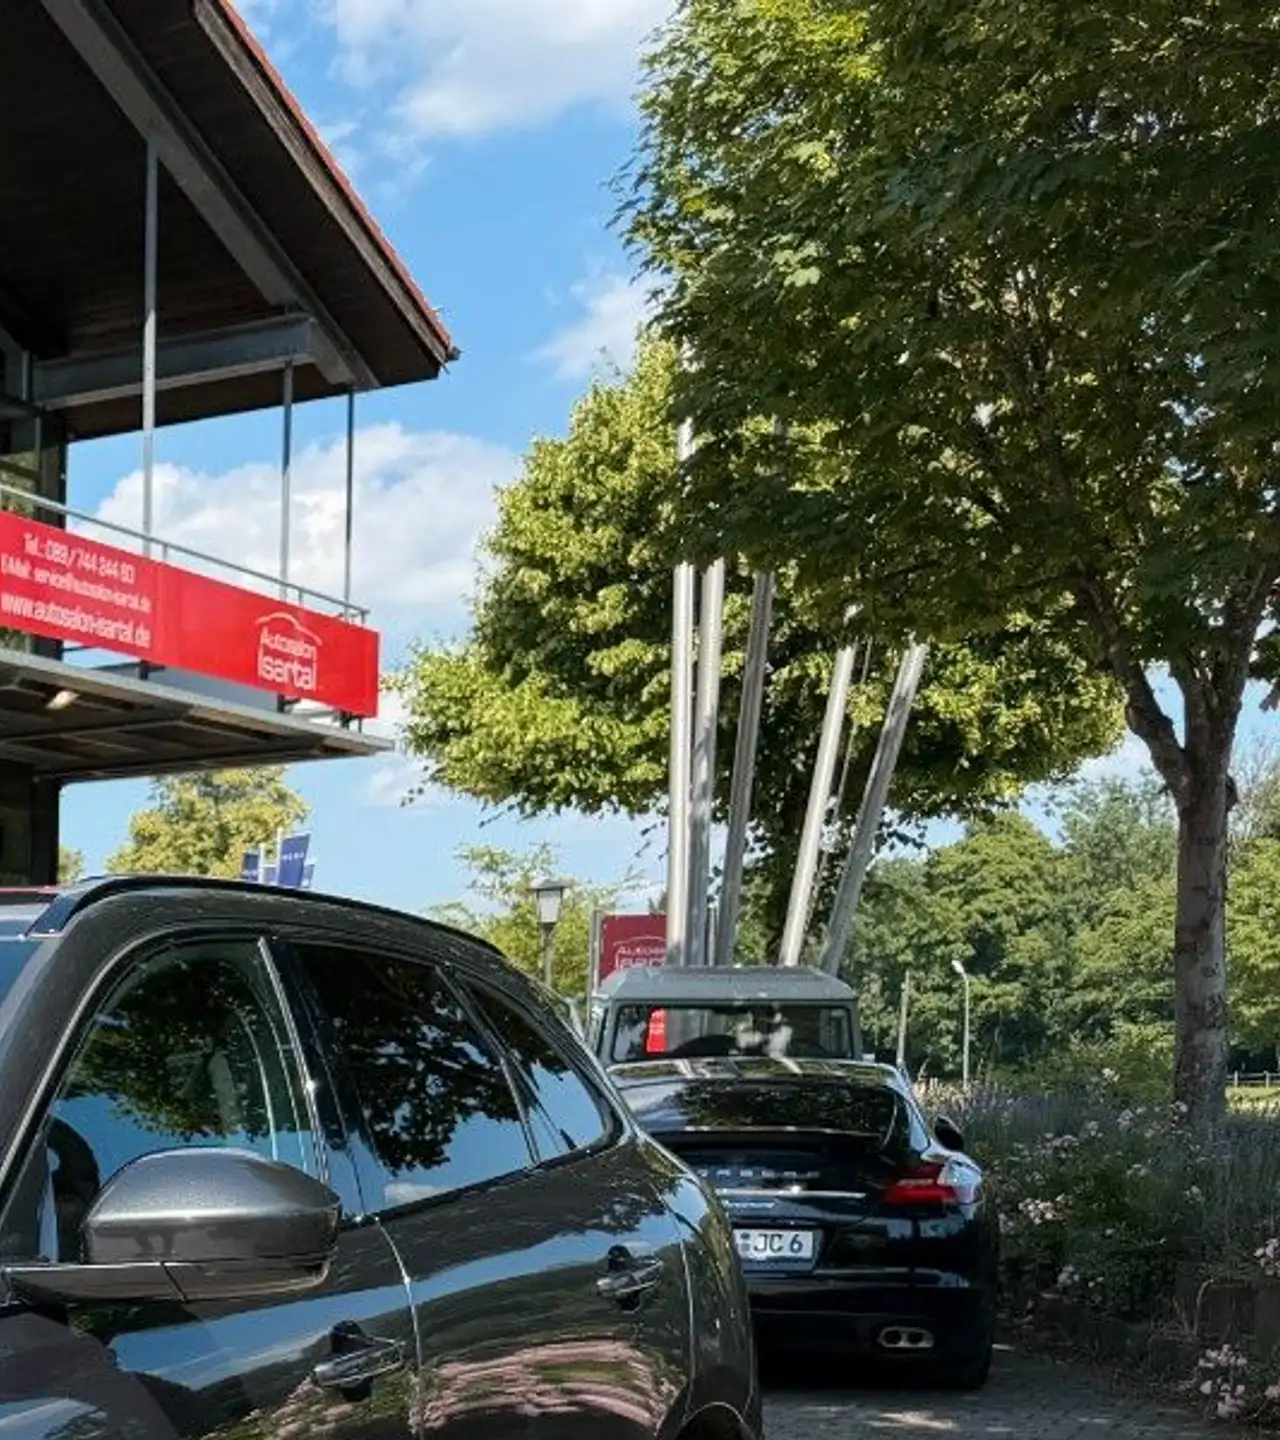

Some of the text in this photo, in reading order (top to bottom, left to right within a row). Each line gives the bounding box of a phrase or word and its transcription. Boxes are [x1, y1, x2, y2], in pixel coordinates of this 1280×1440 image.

[0, 592, 151, 648] www.autosalon-isartal.de
[260, 626, 317, 661] Autosalon
[258, 645, 317, 692] Isartal
[753, 1232, 803, 1254] JC 6
